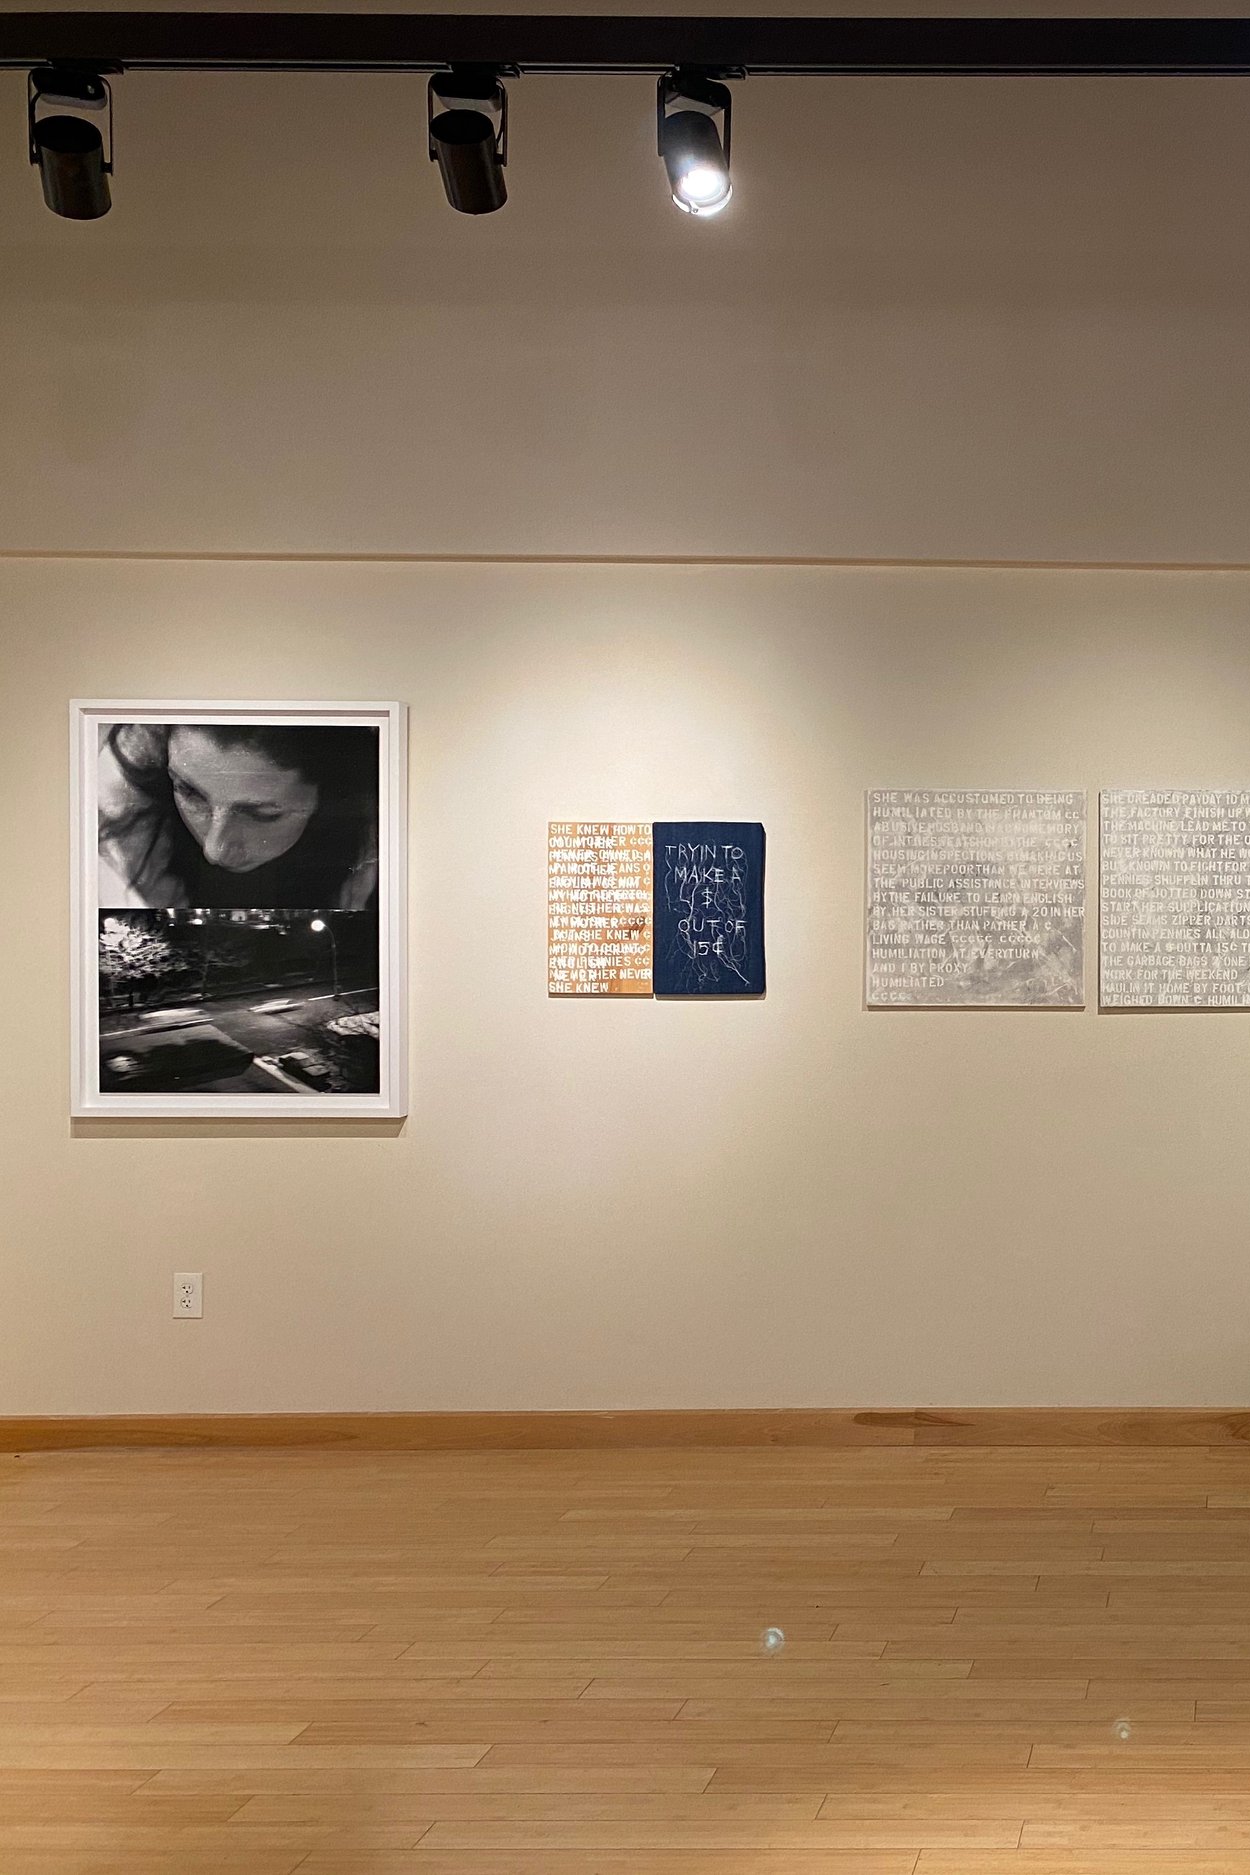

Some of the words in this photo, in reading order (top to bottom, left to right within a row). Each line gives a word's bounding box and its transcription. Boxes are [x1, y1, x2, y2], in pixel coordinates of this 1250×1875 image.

[873, 792, 897, 804] SHE
[904, 792, 930, 804] WAS
[934, 792, 1014, 804] ACCUSTOMED
[1018, 792, 1033, 804] TO
[1036, 792, 1073, 804] BEING
[957, 807, 972, 818] BY
[550, 824, 572, 834] SHE
[576, 824, 609, 834] KNEW
[613, 824, 636, 834] HOW
[637, 824, 651, 834] TO
[1181, 821, 1210, 832] LEAD
[1230, 821, 1246, 832] TO
[1193, 834, 1214, 846] FOR
[1218, 834, 1240, 846] THE
[665, 843, 716, 862] TRYIN
[721, 844, 744, 860] TO
[944, 864, 974, 874] POOR
[976, 864, 1004, 874] THAN
[1065, 864, 1079, 874] AT
[1225, 861, 1246, 872] FOR
[674, 864, 724, 884] MAKE
[732, 866, 742, 883] A
[873, 878, 896, 888] THE
[902, 878, 944, 888] PUBLIC
[1213, 875, 1241, 886] THRU
[873, 892, 887, 903] BY
[889, 892, 910, 903] THE
[914, 892, 960, 903] FAILURE
[967, 892, 980, 903] TO
[1102, 888, 1132, 899] BOOK
[1200, 888, 1232, 899] DOWN
[918, 906, 957, 917] SISTER
[1032, 906, 1048, 917] 20
[678, 918, 722, 932] OUT
[724, 920, 748, 934] OF
[948, 920, 980, 930] THAN
[606, 930, 639, 940] KNEW
[873, 934, 909, 944] LIVING
[915, 934, 946, 944] WAGE
[872, 948, 946, 959] HUMILIATION
[910, 963, 925, 974] BY
[549, 982, 572, 992] SHE
[576, 982, 608, 992] KNEW
[872, 977, 944, 988] HUMILIATED
